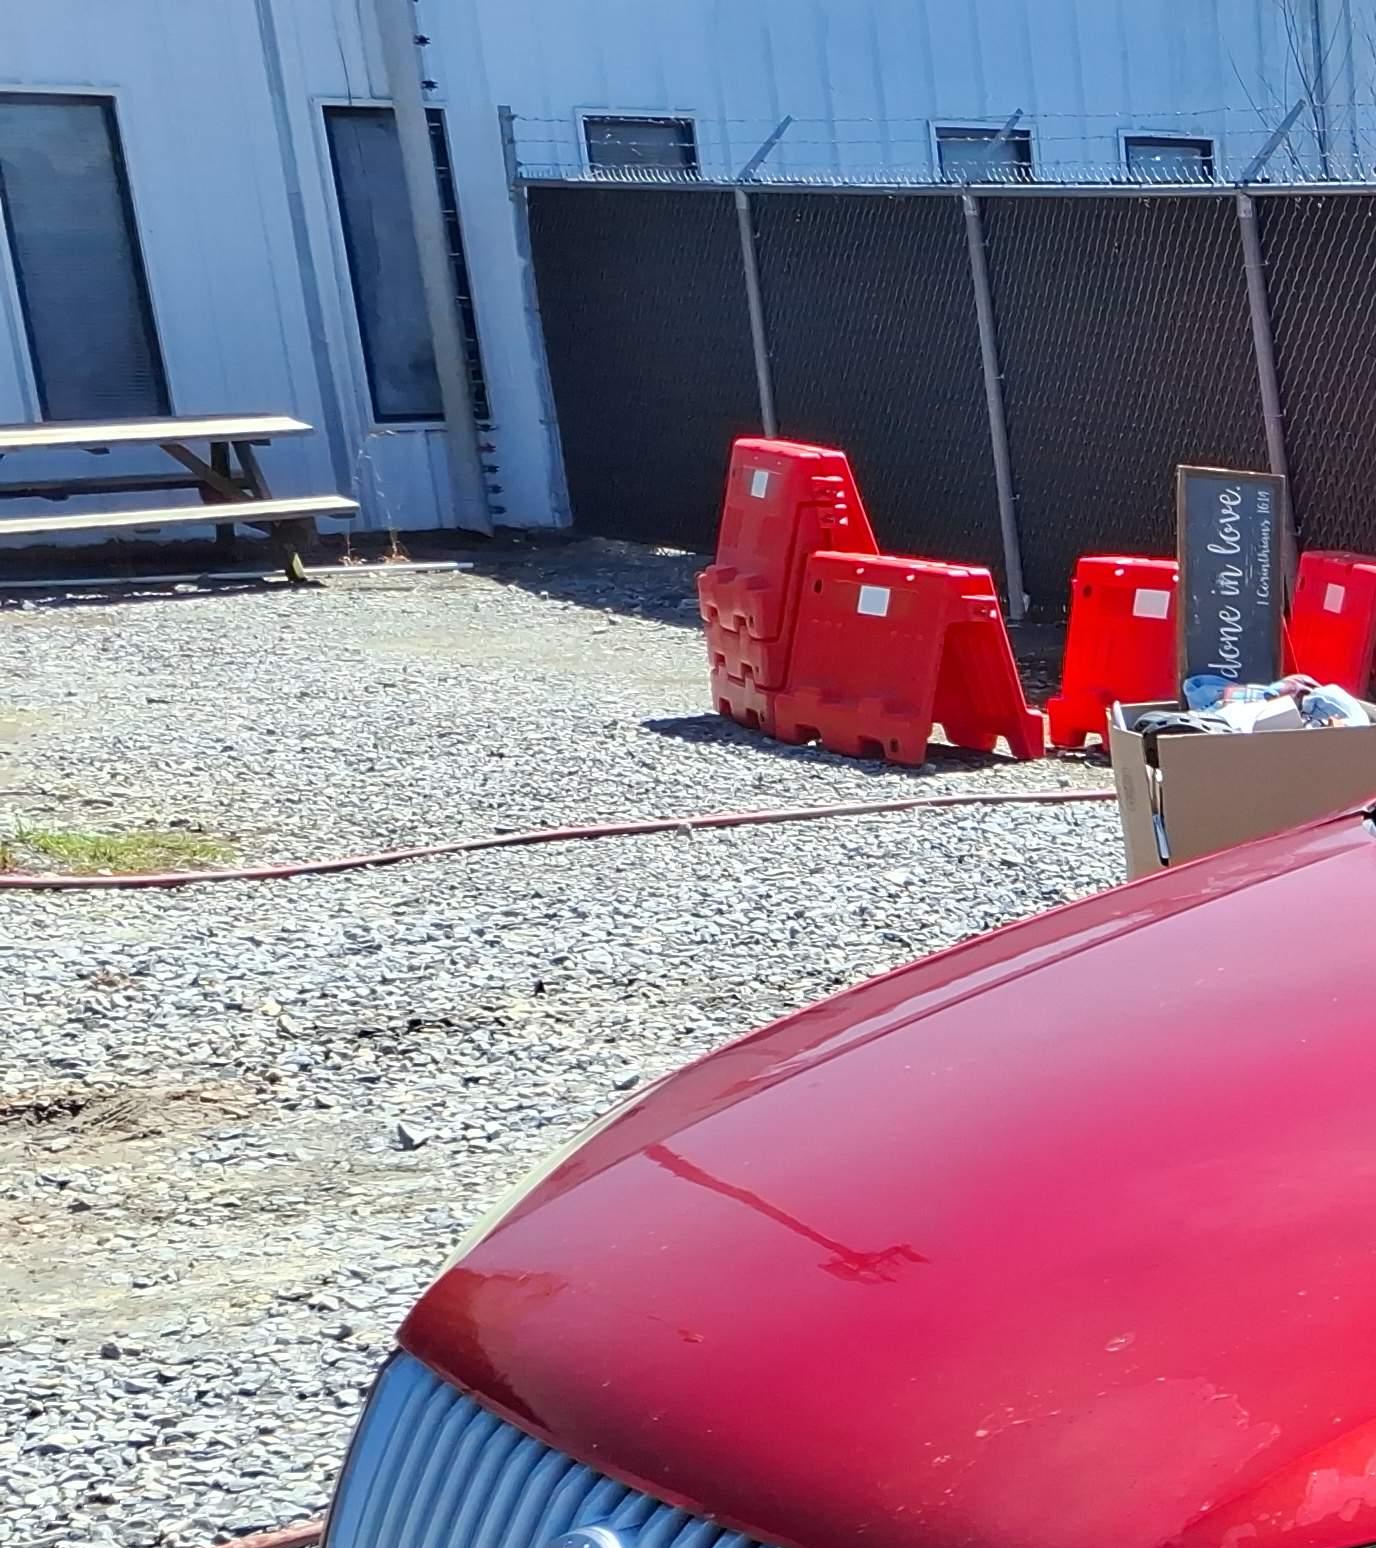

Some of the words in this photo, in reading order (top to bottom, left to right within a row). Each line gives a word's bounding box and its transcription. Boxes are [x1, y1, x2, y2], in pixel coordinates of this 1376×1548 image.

[1207, 485, 1243, 556] love.
[1211, 564, 1244, 597] in
[1256, 518, 1272, 599] Corinthians
[1208, 604, 1243, 679] done
